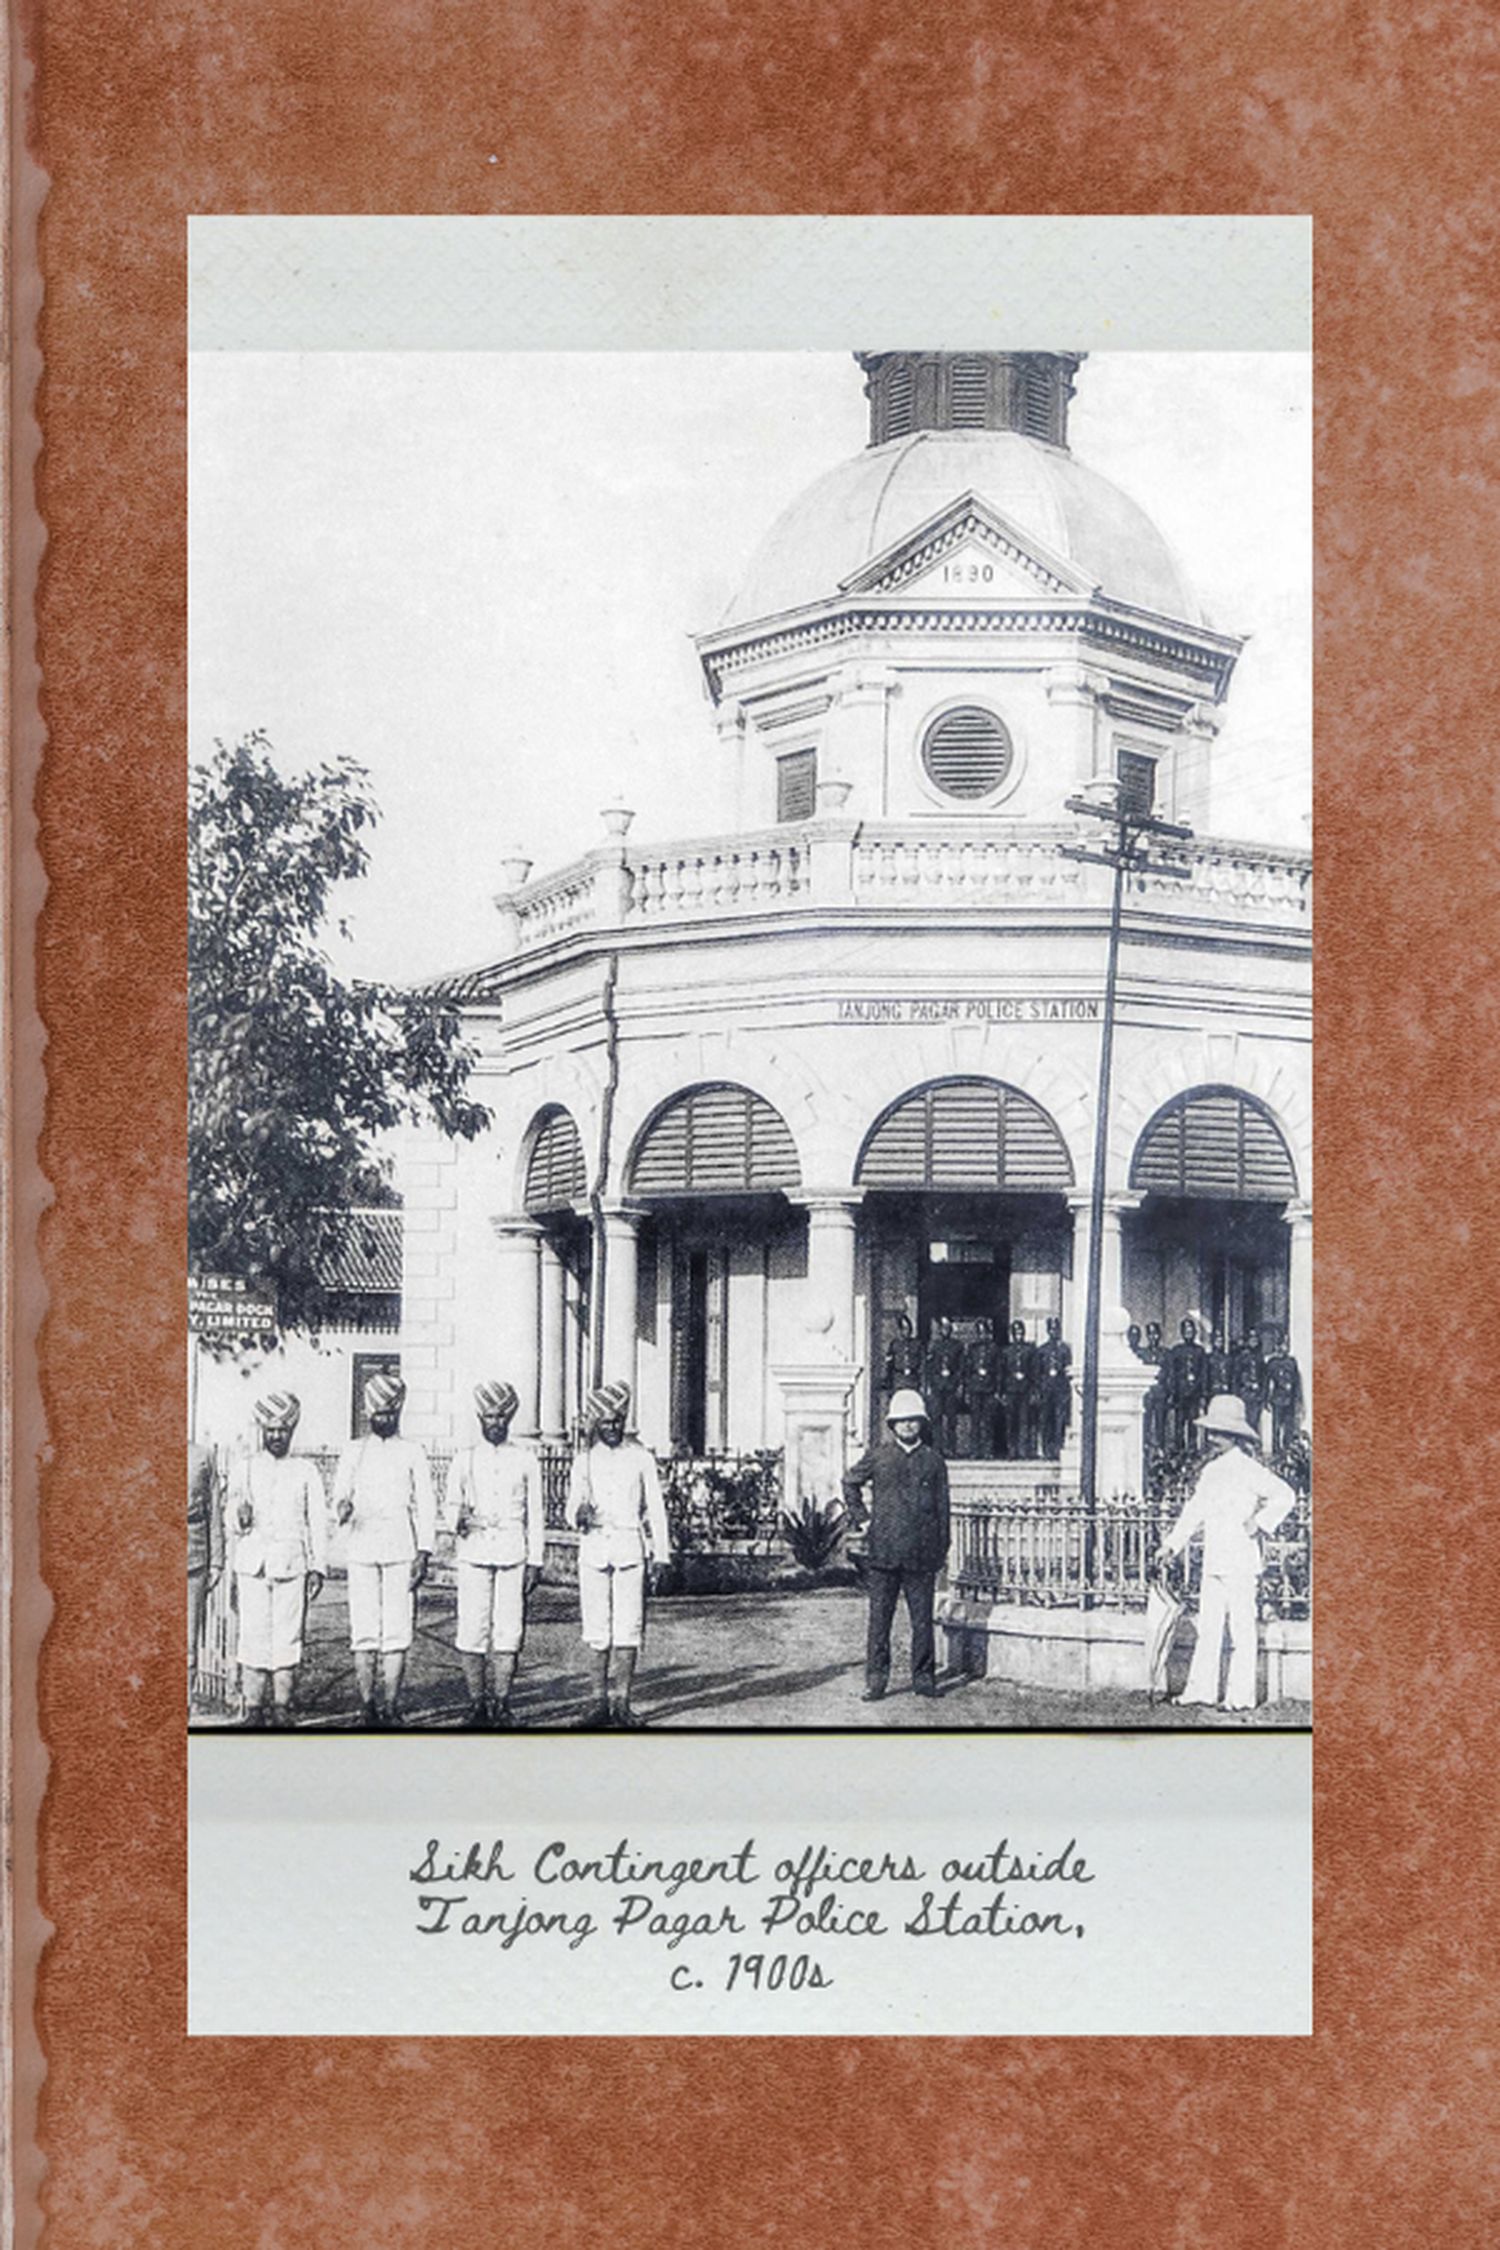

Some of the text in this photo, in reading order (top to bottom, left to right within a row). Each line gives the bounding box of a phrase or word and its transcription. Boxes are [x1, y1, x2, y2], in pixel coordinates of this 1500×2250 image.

[837, 1000, 1099, 1021] TANJONG PAGAR POLICE STATION
[235, 1302, 274, 1316] DOCK
[207, 1315, 272, 1328] LIMITED
